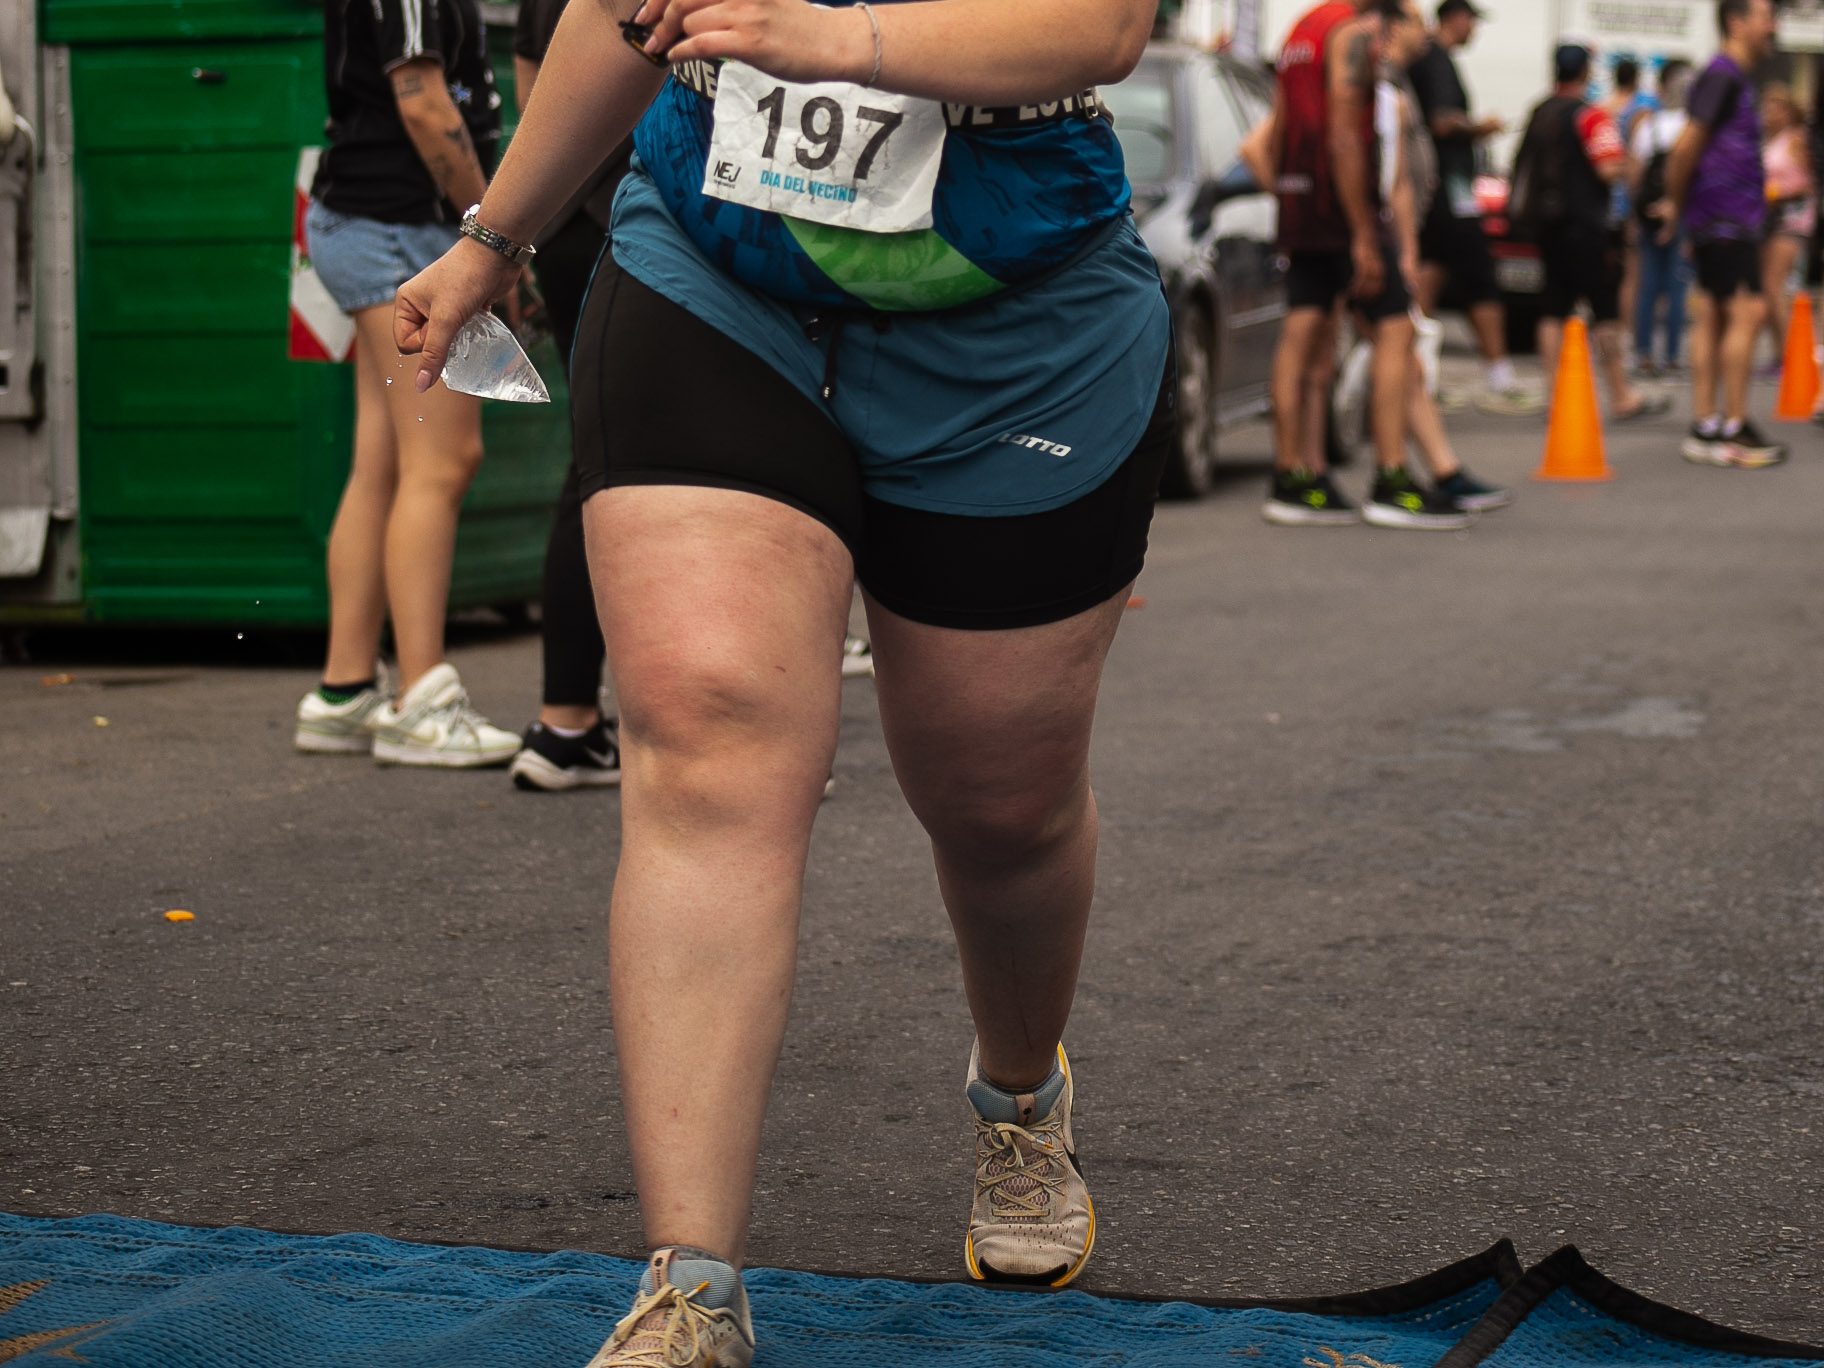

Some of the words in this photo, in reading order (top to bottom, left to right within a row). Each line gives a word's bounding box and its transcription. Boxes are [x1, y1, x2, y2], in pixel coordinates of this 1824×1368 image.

[757, 86, 904, 180] 197
[783, 175, 806, 194] DEL
[808, 181, 859, 204] VECINO
